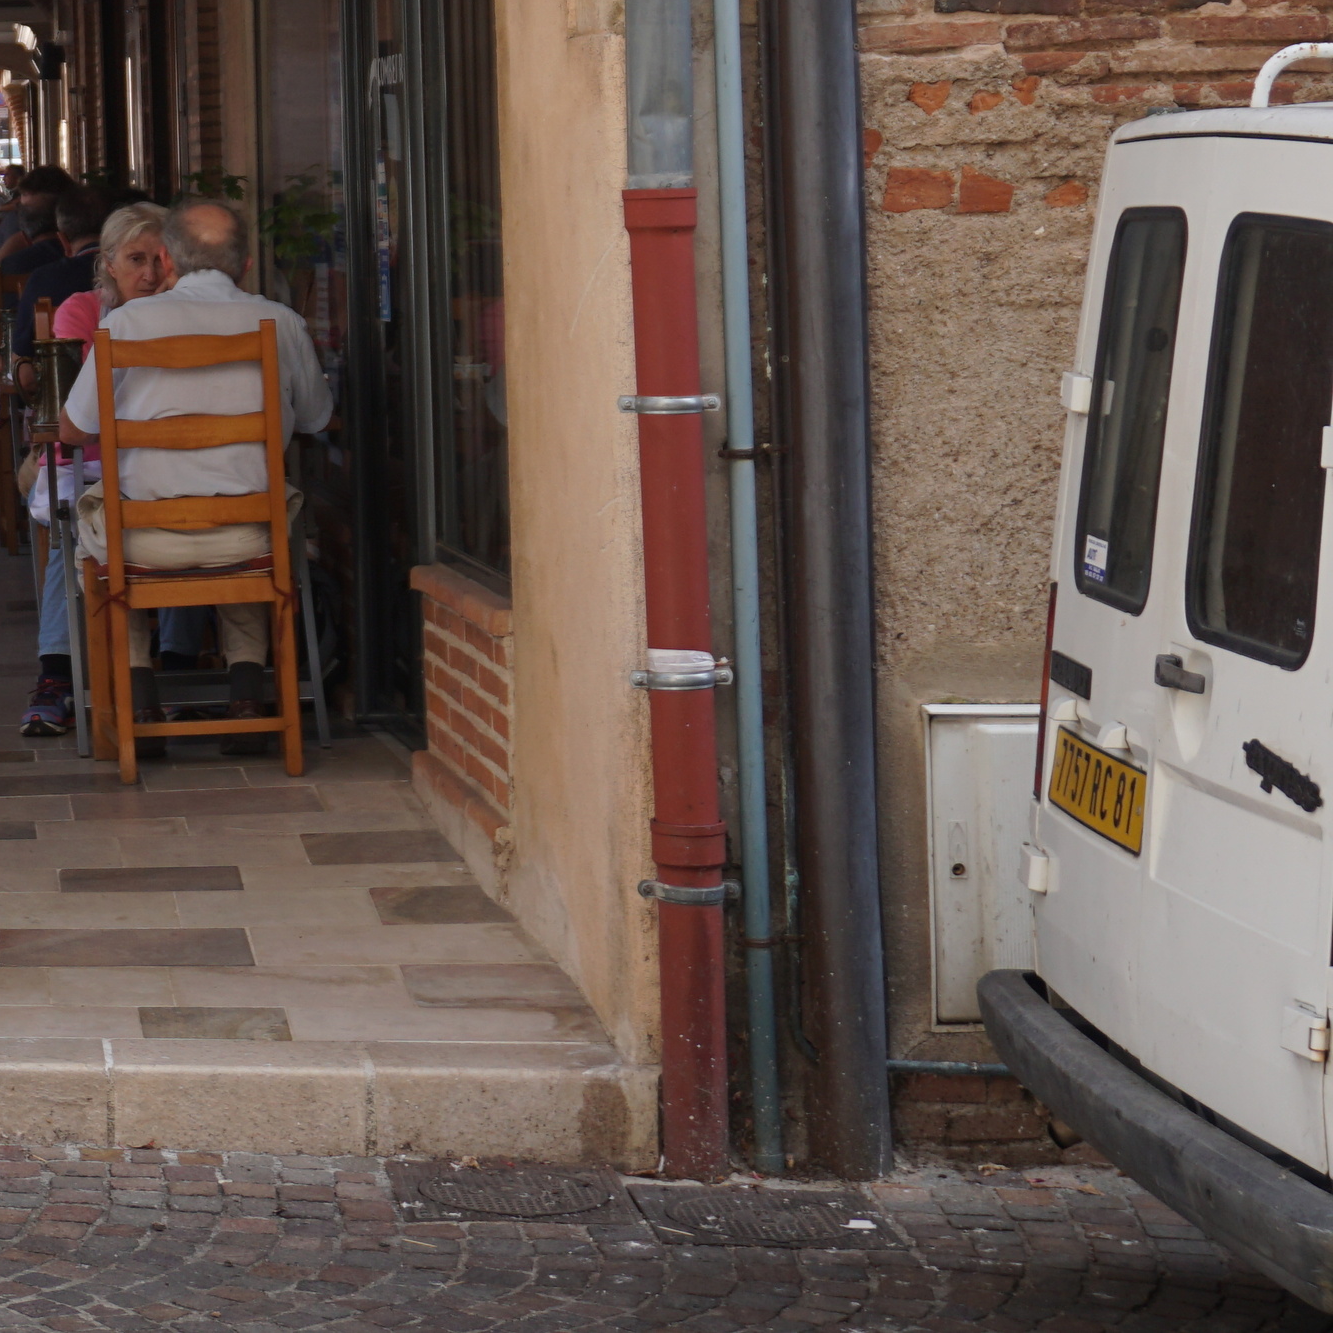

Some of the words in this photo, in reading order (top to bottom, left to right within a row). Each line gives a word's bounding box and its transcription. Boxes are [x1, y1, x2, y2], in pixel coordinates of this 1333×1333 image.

[1057, 738, 1091, 807] 7757
[1089, 760, 1112, 820] RC
[1113, 771, 1137, 835] 81
